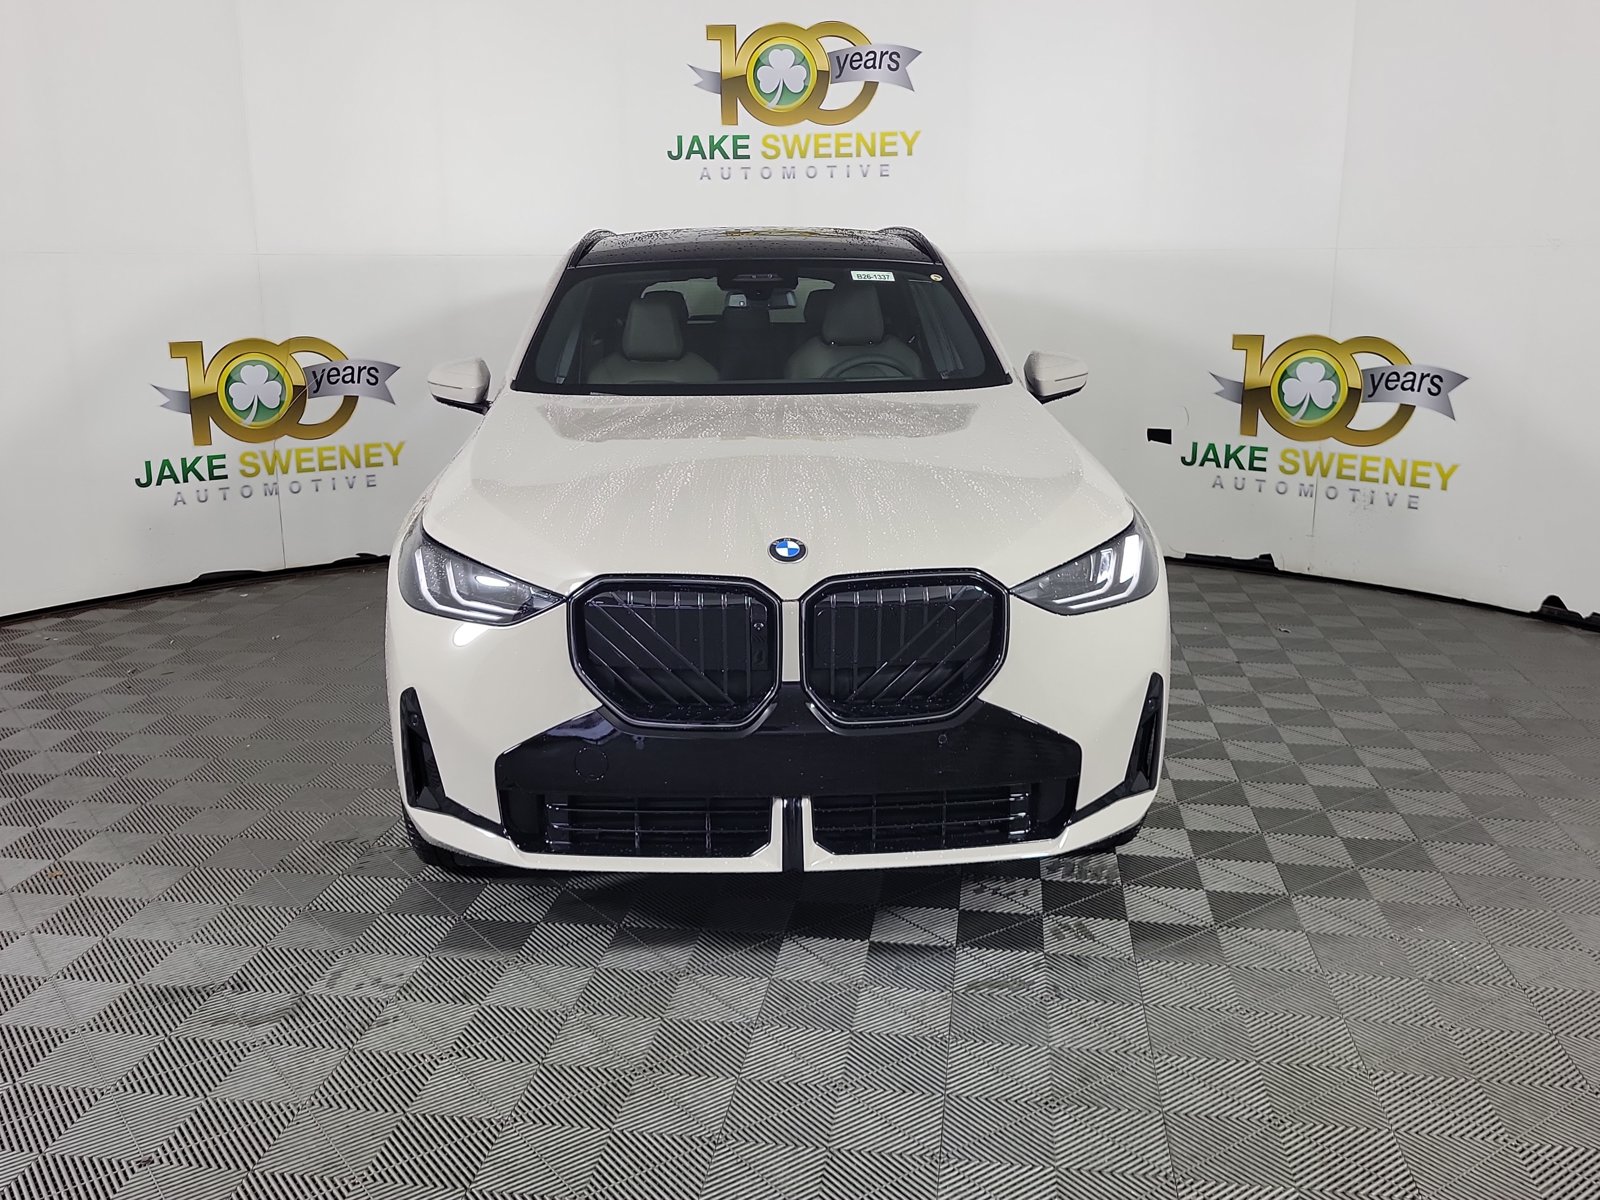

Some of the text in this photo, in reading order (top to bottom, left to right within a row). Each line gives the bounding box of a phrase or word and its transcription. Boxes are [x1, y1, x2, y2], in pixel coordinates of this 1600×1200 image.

[706, 21, 901, 126] 100 years
[667, 131, 921, 160] JAKE SWEENEY
[700, 164, 890, 180] AUTOMOTIVE
[169, 336, 379, 446] 100 years
[1232, 334, 1444, 447] 100 years
[135, 442, 405, 488] JAKE SWEENEY
[1180, 442, 1460, 491] JAKE SWEENEY
[173, 474, 377, 506] AUTOMOTIVE
[1212, 475, 1419, 510] AUTOMOTIVE
